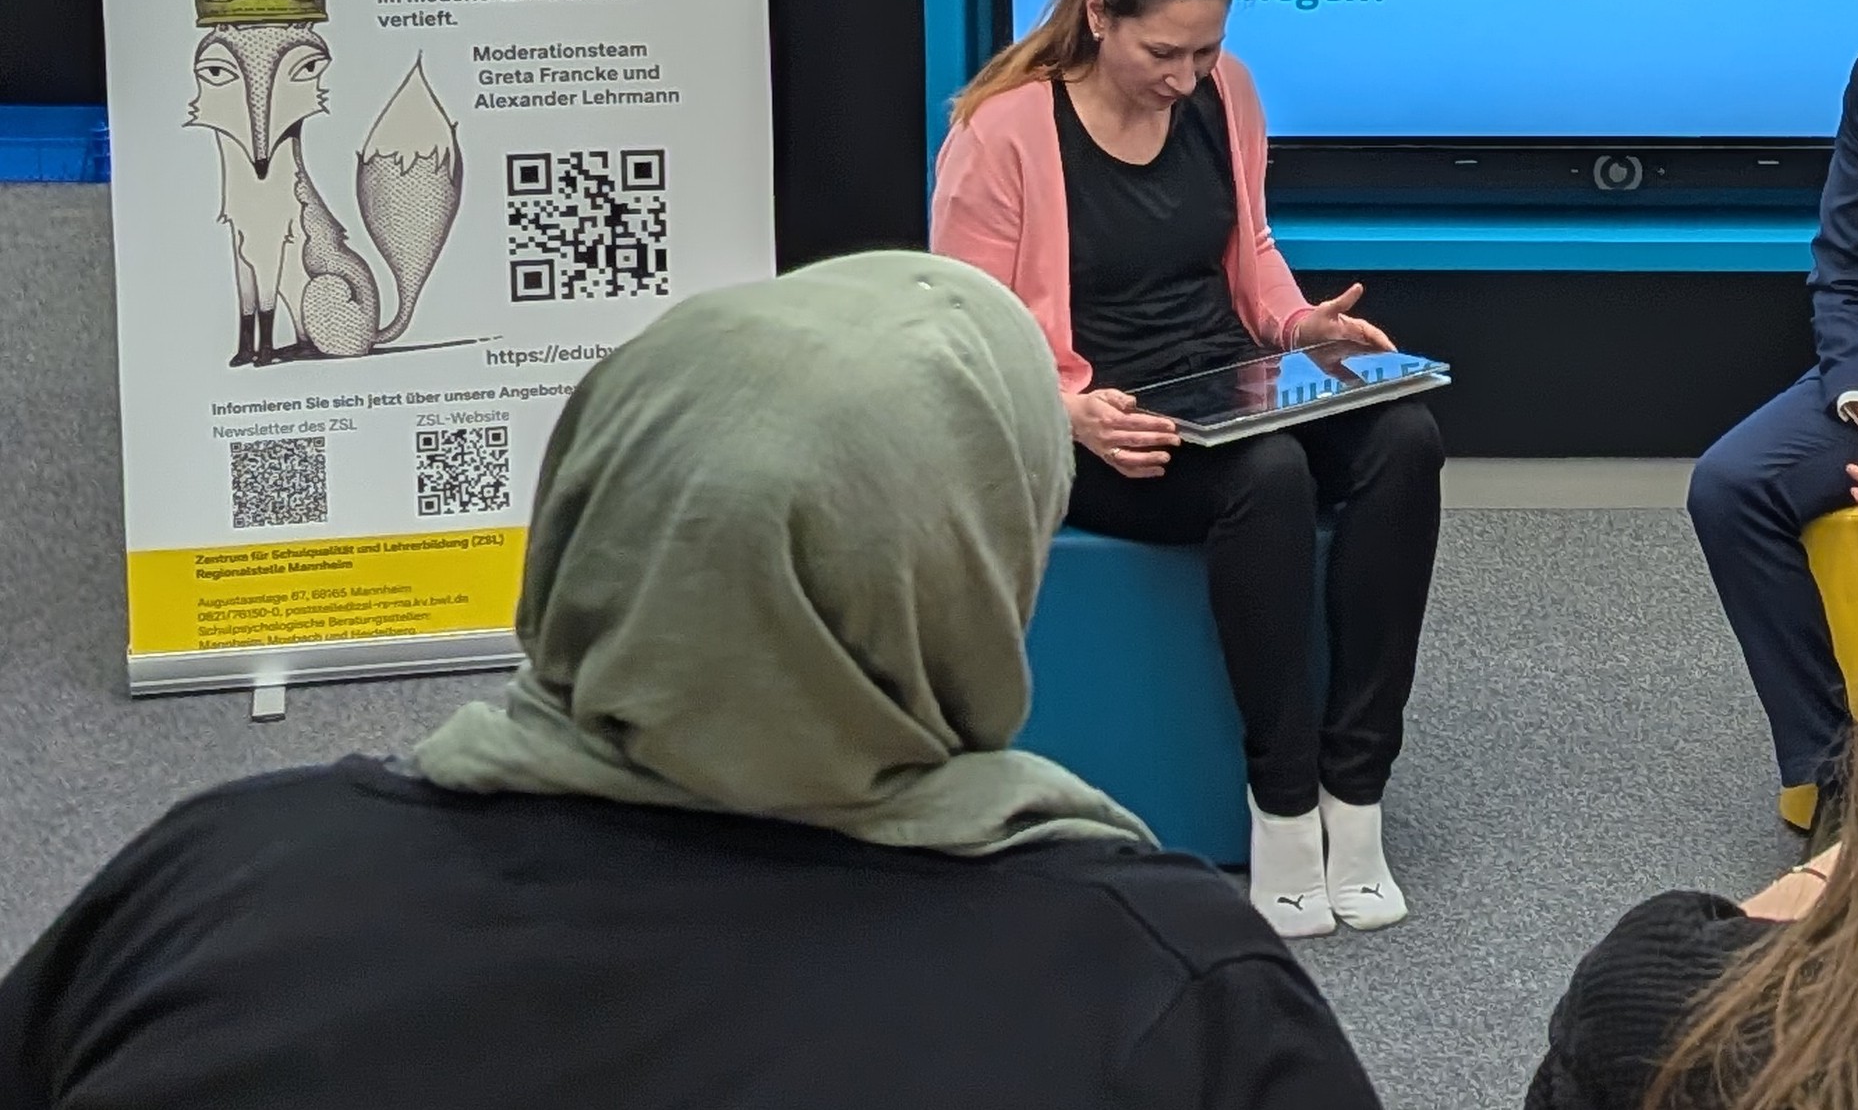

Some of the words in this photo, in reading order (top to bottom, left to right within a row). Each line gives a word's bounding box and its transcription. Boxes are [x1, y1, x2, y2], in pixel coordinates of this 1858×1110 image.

[378, 10, 458, 27] vertieft.
[474, 42, 647, 61] Moderationsteam
[479, 69, 534, 85] Greta
[540, 66, 618, 83] Francke
[623, 65, 659, 80] und
[475, 91, 577, 109] Alexander
[583, 89, 679, 105] Lehrmann
[212, 400, 301, 415] Informieren
[306, 396, 329, 409] Sie
[333, 394, 364, 408] sich
[368, 393, 402, 409] jetzt
[406, 391, 441, 404] über
[444, 389, 495, 402] unsere
[213, 422, 295, 438] Newsletter
[298, 420, 325, 433] des
[329, 418, 357, 432] ZSL
[416, 409, 509, 427] ZSL-Website
